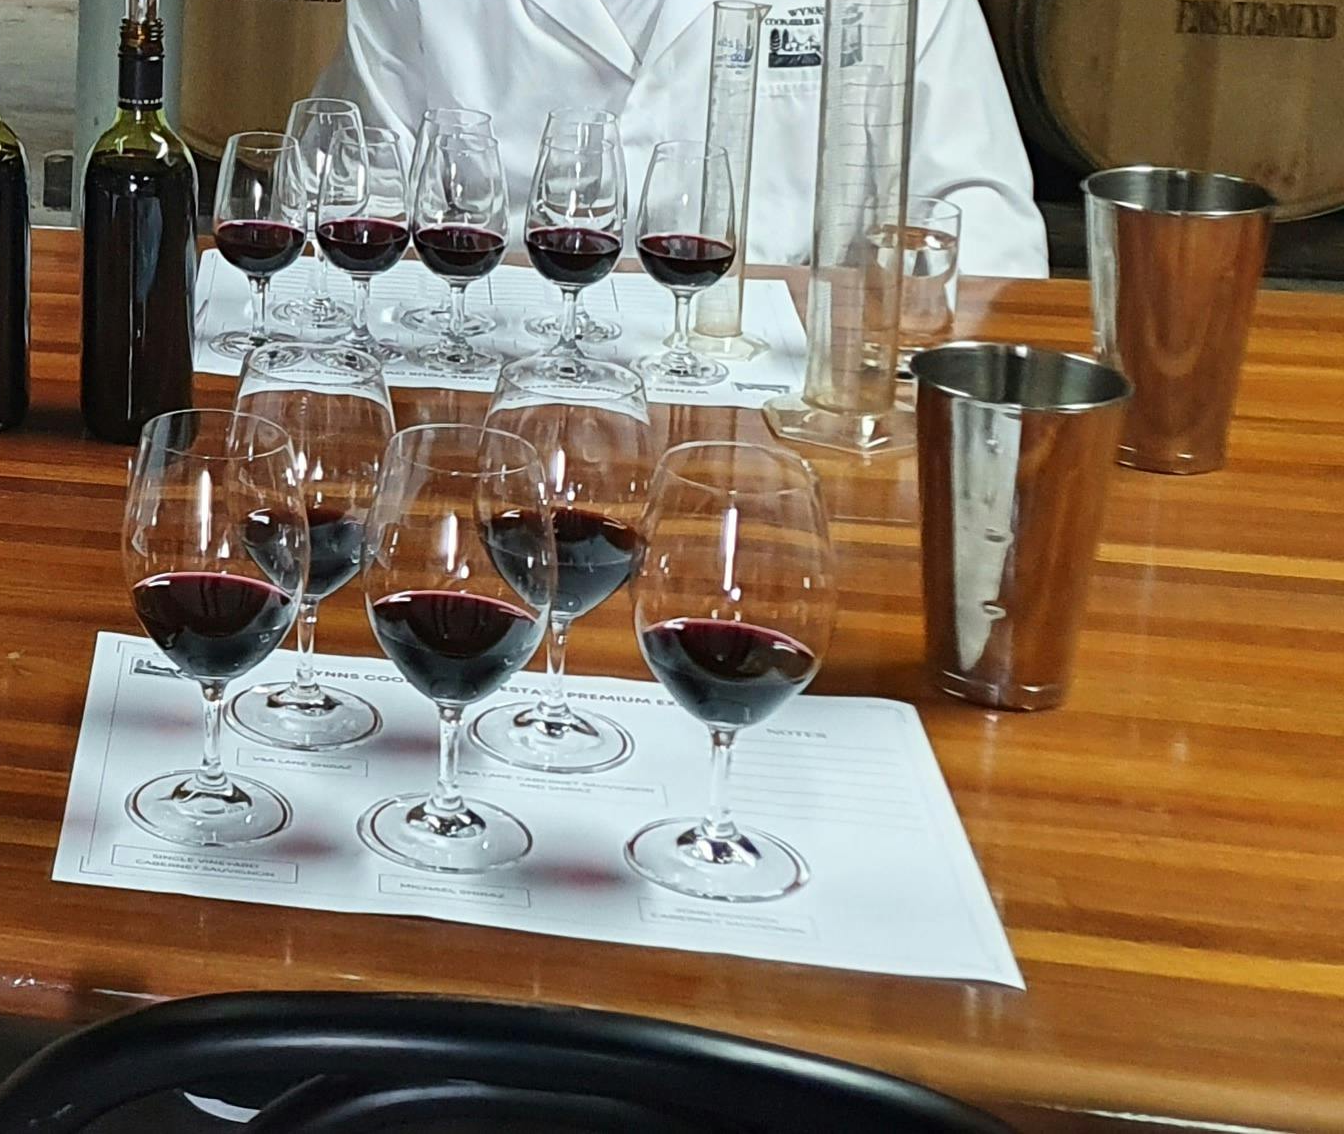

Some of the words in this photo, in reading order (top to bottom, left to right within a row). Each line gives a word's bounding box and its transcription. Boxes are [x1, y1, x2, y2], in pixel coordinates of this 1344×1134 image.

[311, 669, 360, 681] YNNS
[500, 685, 544, 697] ESTA
[567, 691, 651, 705] PREMIUM
